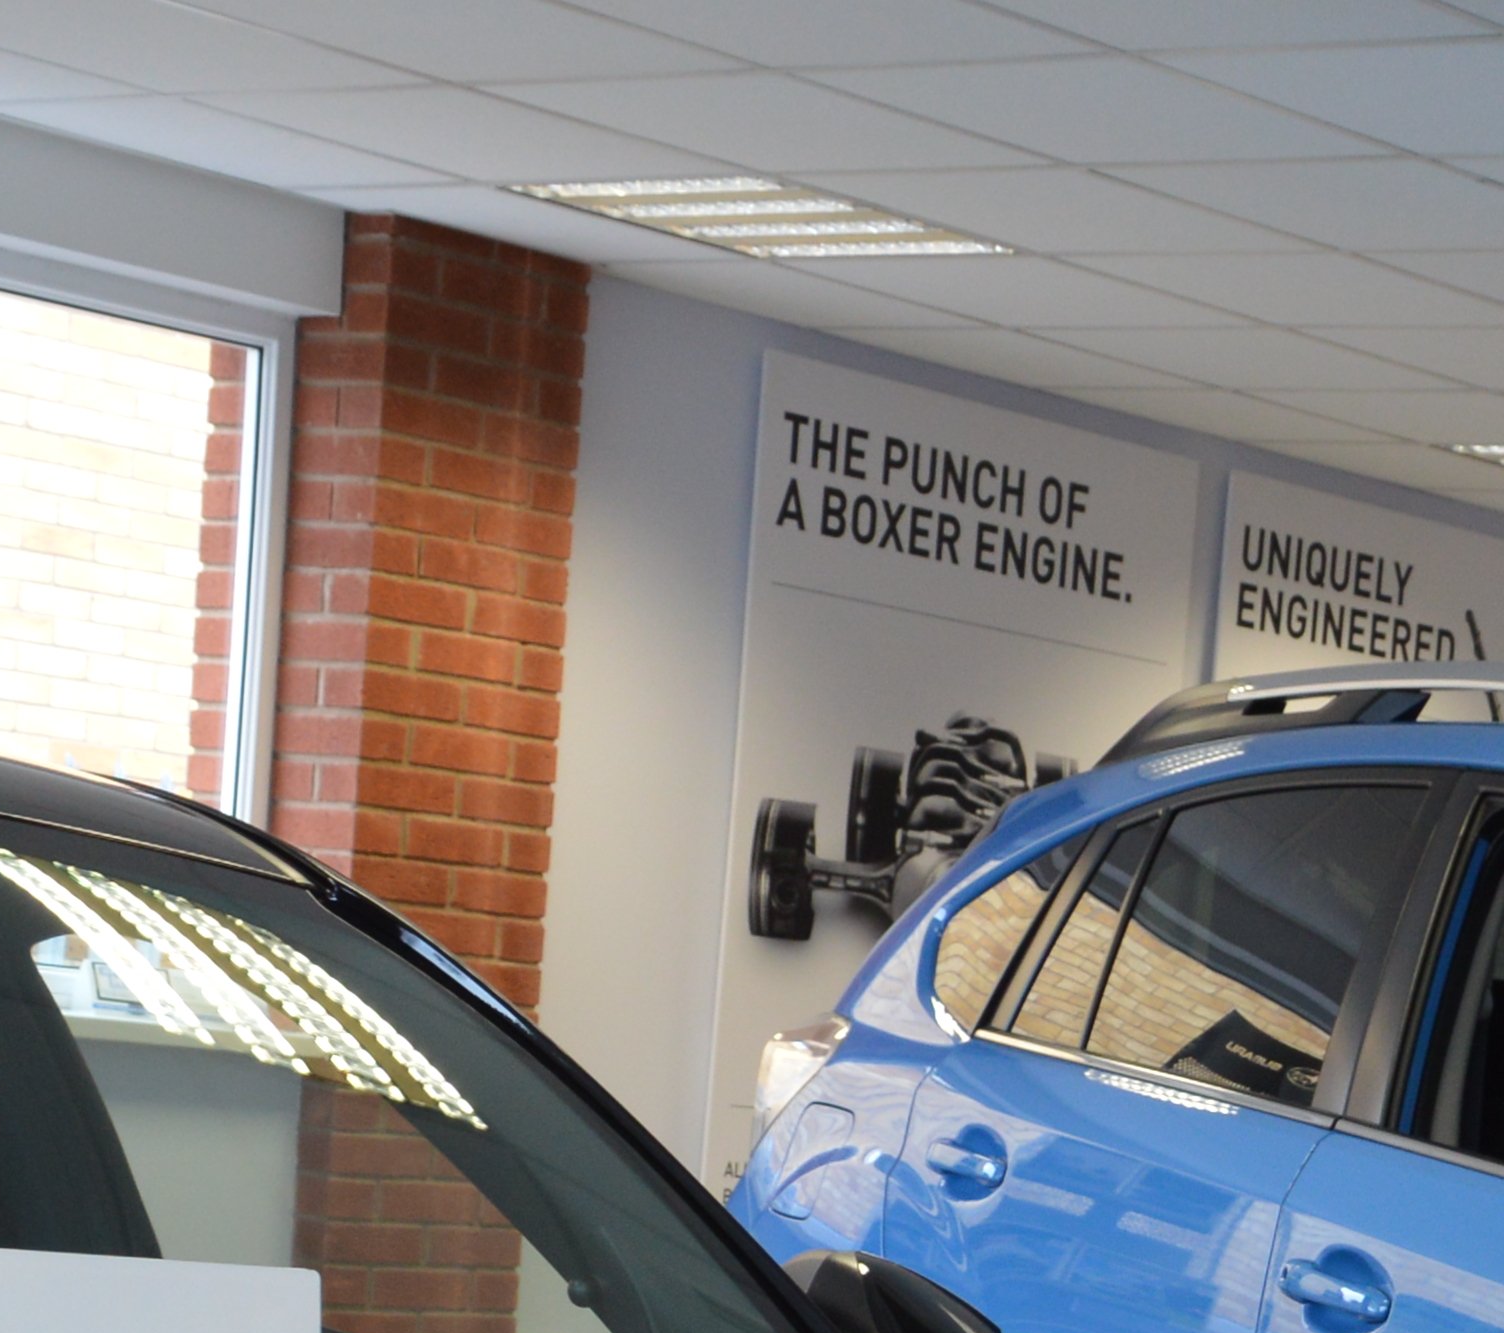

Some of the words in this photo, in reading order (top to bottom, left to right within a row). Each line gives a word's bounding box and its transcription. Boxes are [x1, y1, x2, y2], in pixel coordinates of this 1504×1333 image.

[783, 411, 869, 480] THE
[882, 436, 1026, 517] PUNCH
[1039, 476, 1090, 529] OF
[776, 478, 806, 531] A
[820, 486, 961, 565] BOXER
[974, 521, 1132, 603] ENGINE.
[1242, 525, 1413, 605] UNIQUELY
[1236, 583, 1455, 662] ENGINEERED
